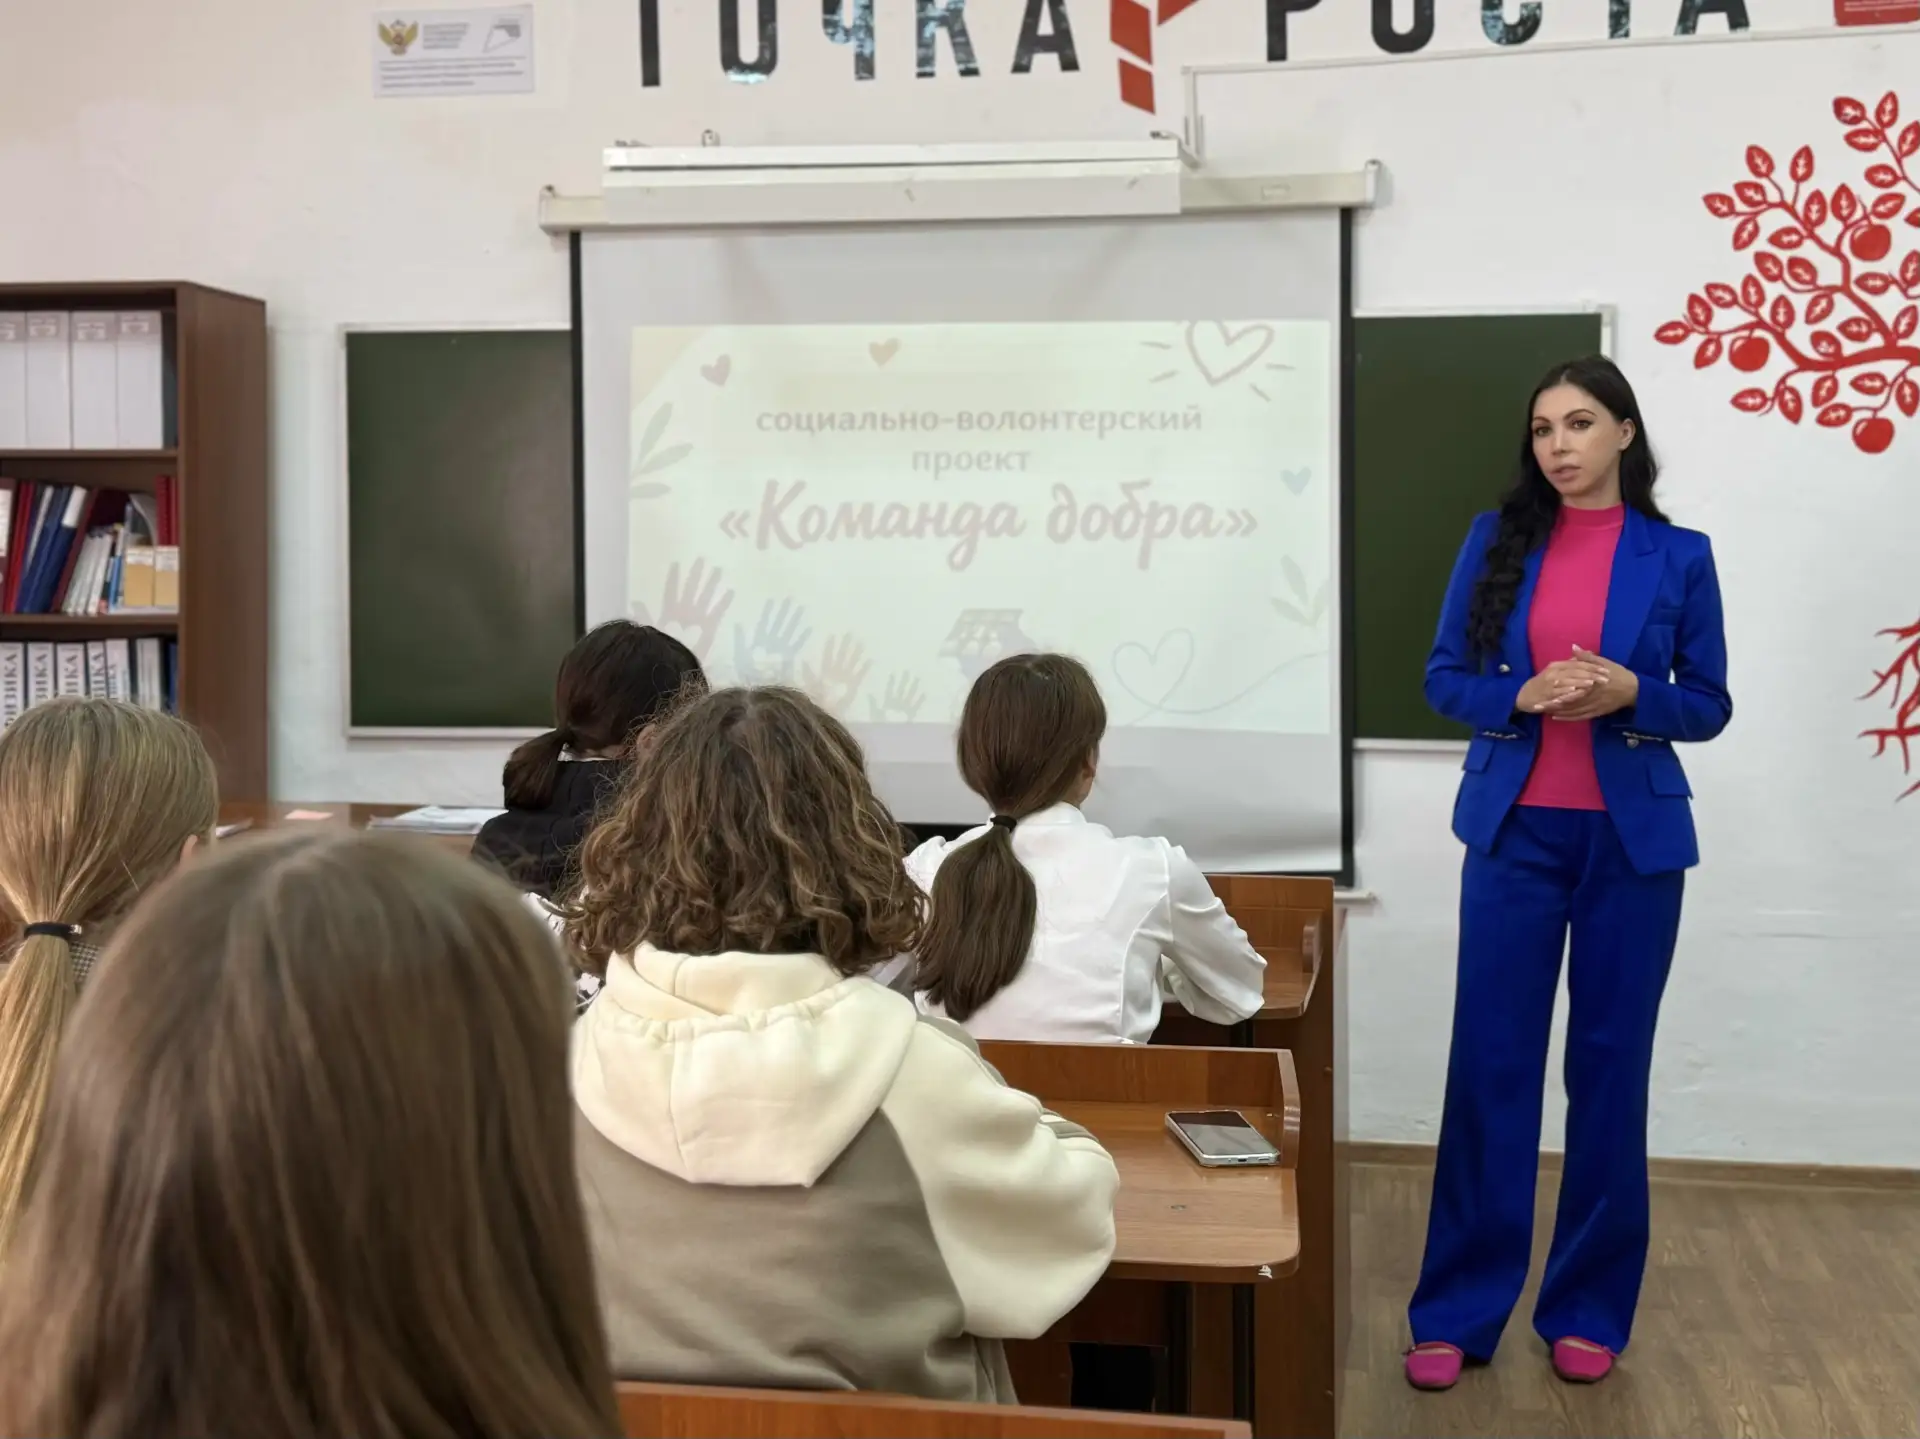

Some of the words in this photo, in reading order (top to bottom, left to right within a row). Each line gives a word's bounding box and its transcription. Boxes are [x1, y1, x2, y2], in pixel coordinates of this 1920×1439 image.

[756, 405, 1203, 437] социально-волонтерский
[912, 448, 1031, 480] проект
[719, 479, 1027, 571] «Команда
[1047, 479, 1259, 571] добра»
